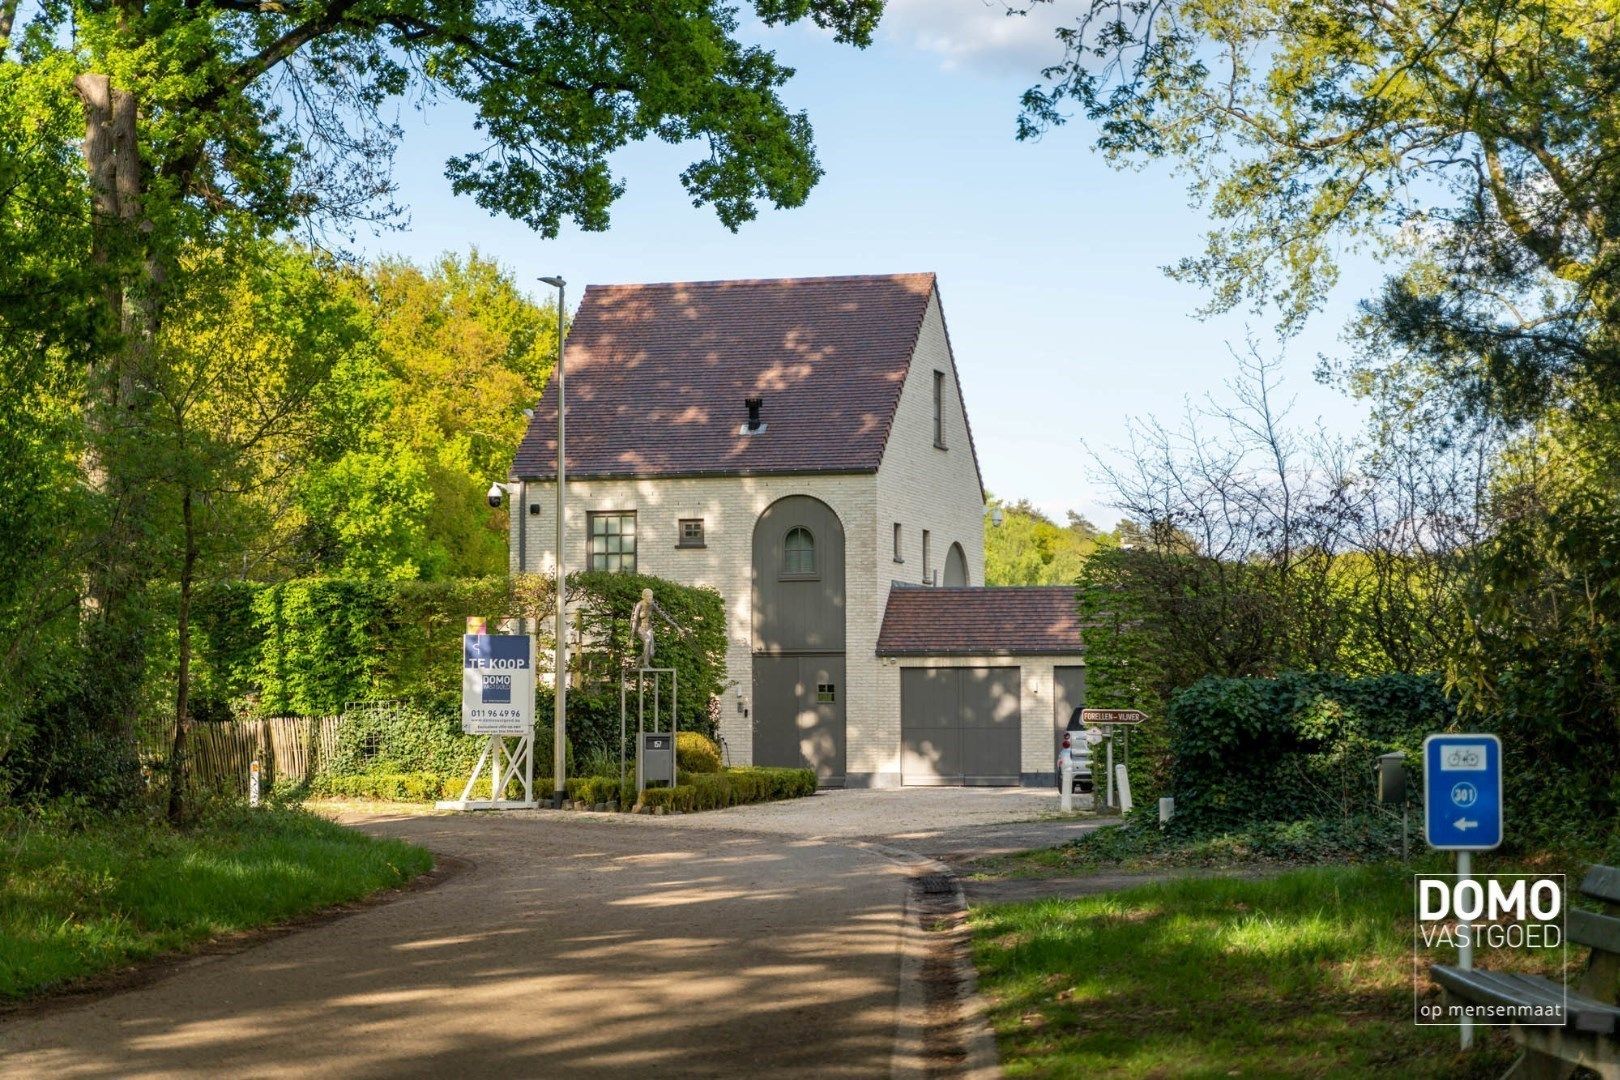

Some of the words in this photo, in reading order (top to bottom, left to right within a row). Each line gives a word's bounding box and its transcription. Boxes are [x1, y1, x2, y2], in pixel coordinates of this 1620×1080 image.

[469, 658, 485, 669] TE
[490, 658, 525, 669] KOOP
[483, 675, 510, 685] DOMO
[471, 709, 485, 717] 011
[488, 709, 497, 718] 96
[499, 709, 509, 718] 49
[511, 709, 520, 717] 96
[1454, 788, 1474, 802] 301
